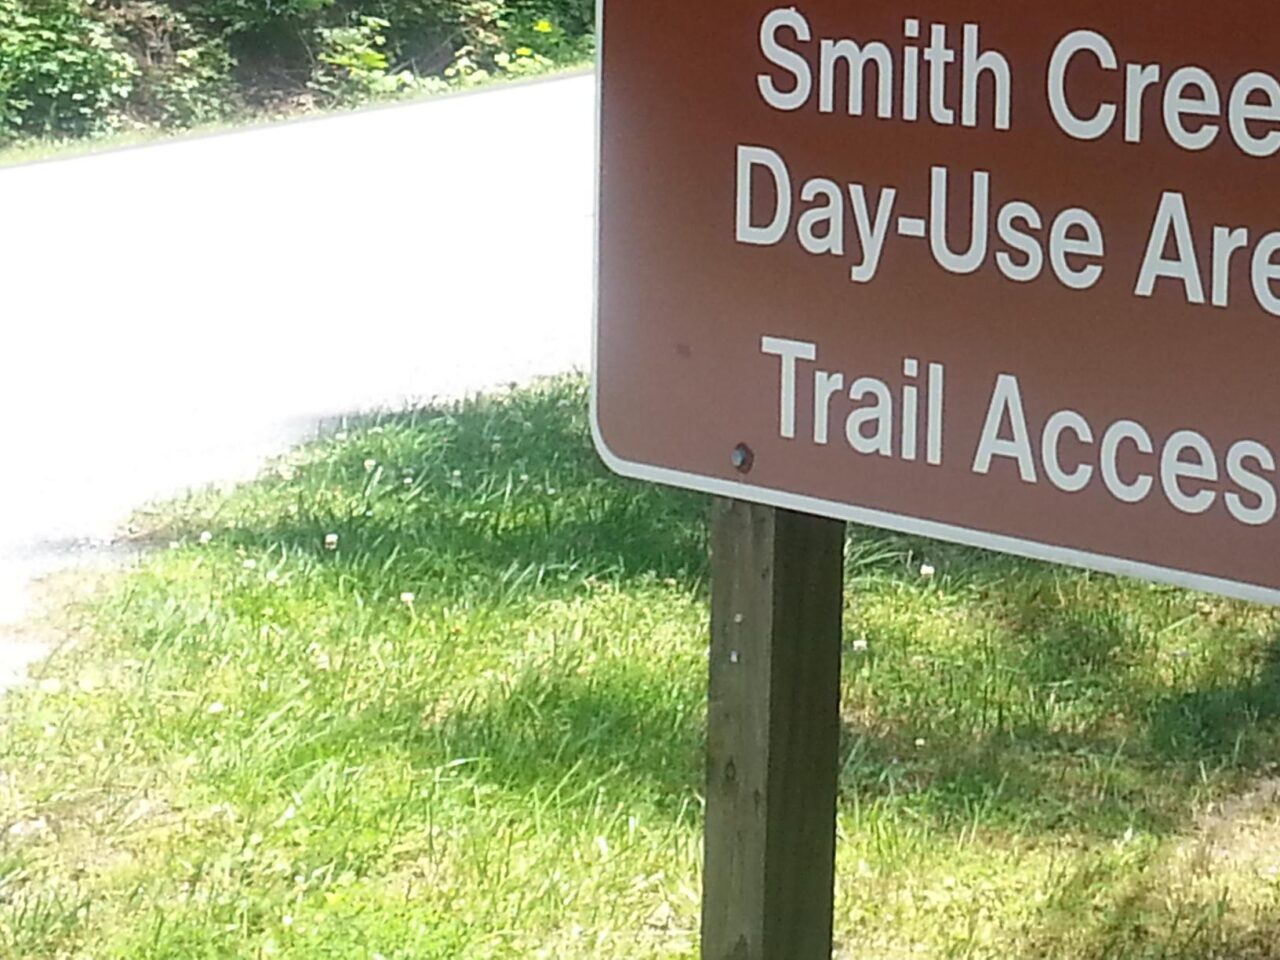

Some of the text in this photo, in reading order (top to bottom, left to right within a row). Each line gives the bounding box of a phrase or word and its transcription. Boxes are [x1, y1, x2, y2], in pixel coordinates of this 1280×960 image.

[757, 6, 1010, 130] Smith
[735, 145, 1104, 289] Day-Use
[761, 335, 943, 466] Trail
